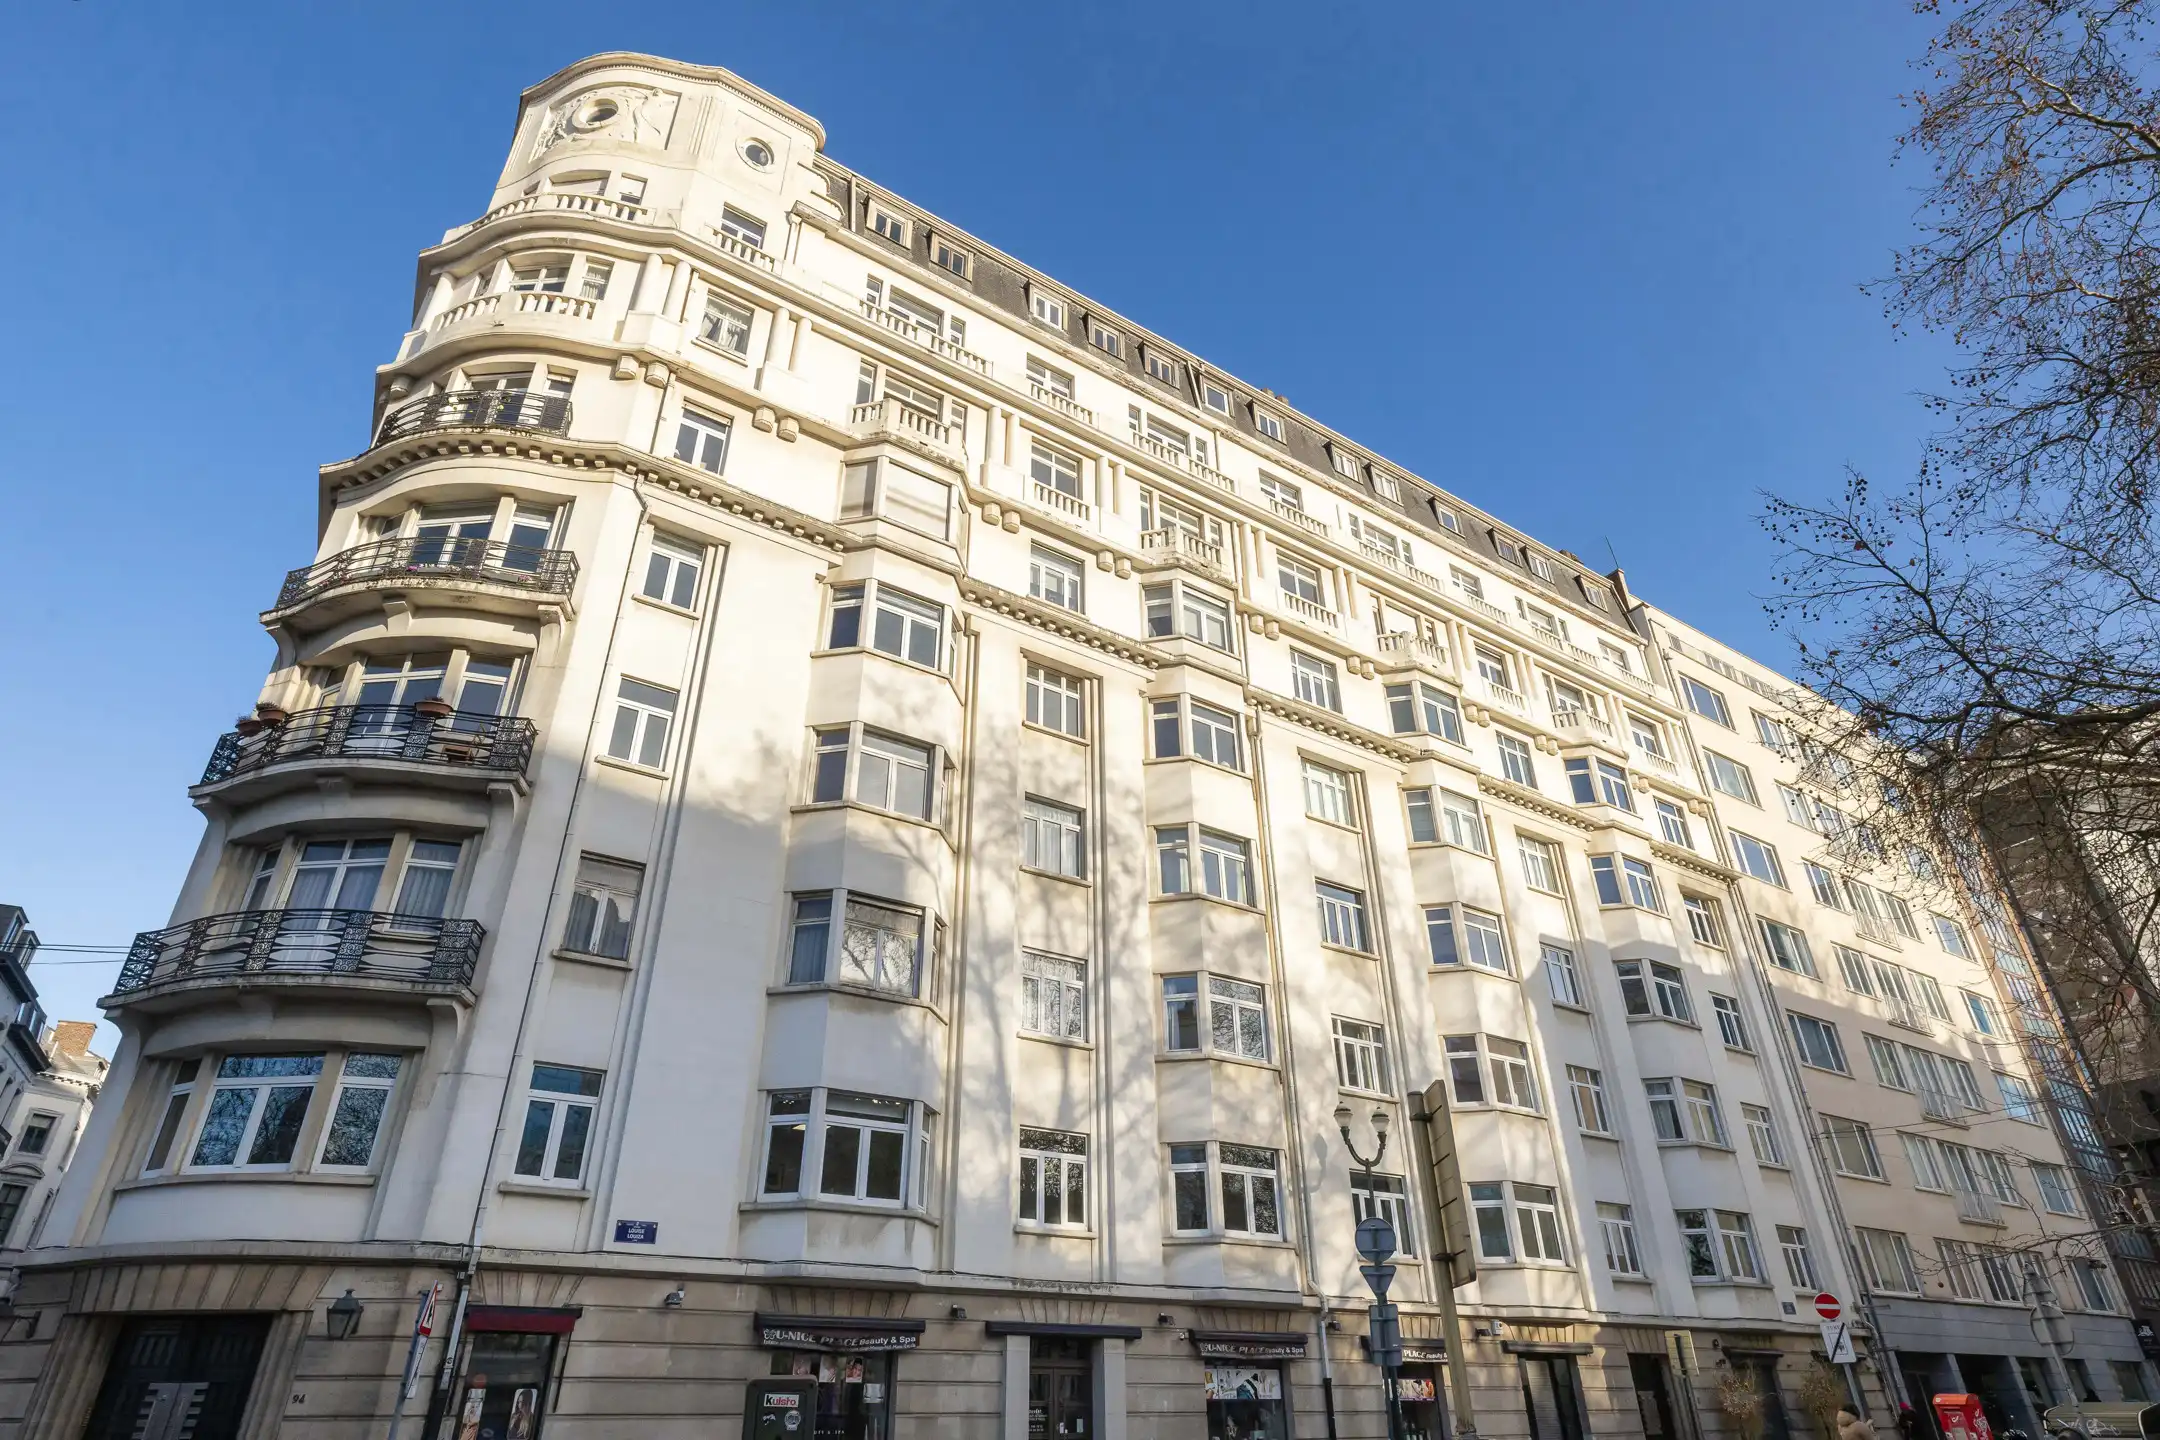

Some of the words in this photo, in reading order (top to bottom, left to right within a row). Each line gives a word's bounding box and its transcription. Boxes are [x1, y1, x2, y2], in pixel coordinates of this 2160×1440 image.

[859, 1337, 888, 1346] Beauty
[899, 1335, 916, 1344] Spa
[1291, 1346, 1304, 1354] Spa
[292, 1393, 306, 1405] 94
